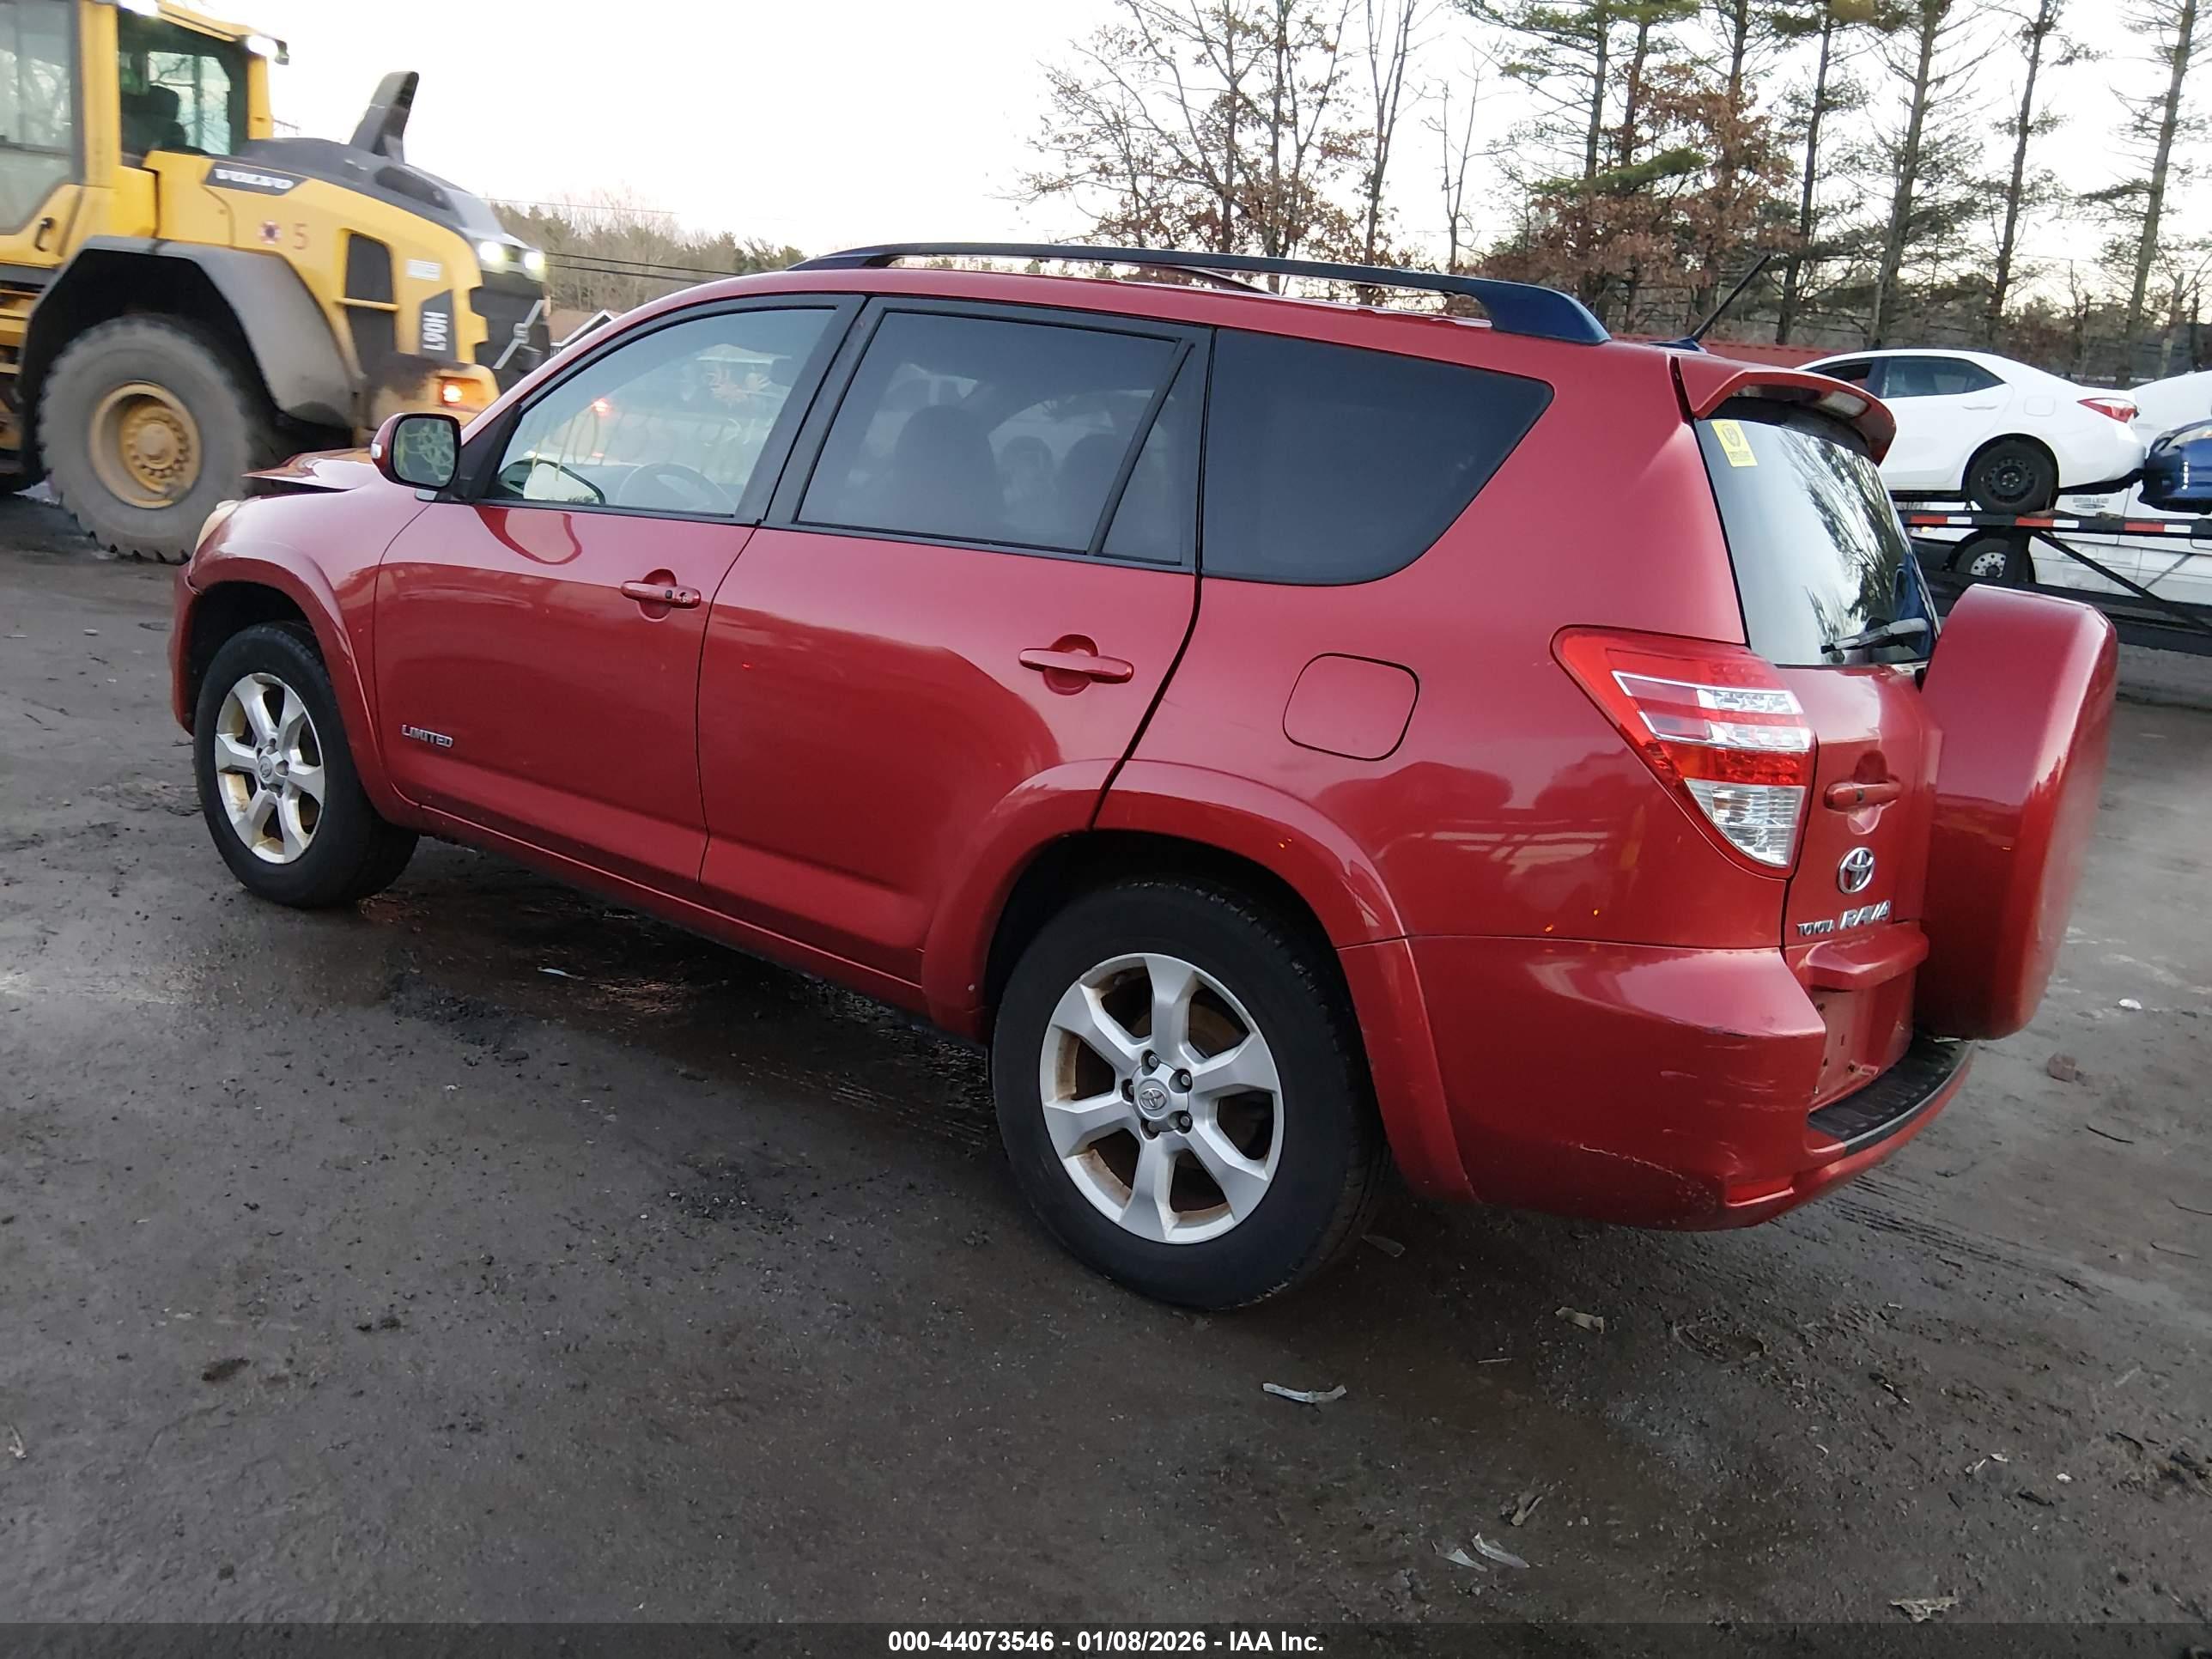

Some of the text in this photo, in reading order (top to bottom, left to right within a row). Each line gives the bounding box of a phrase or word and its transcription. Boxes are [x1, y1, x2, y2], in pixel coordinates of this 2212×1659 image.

[422, 311, 448, 351] L90H
[401, 724, 454, 748] LIMITED
[1839, 899, 1891, 931] RAV4
